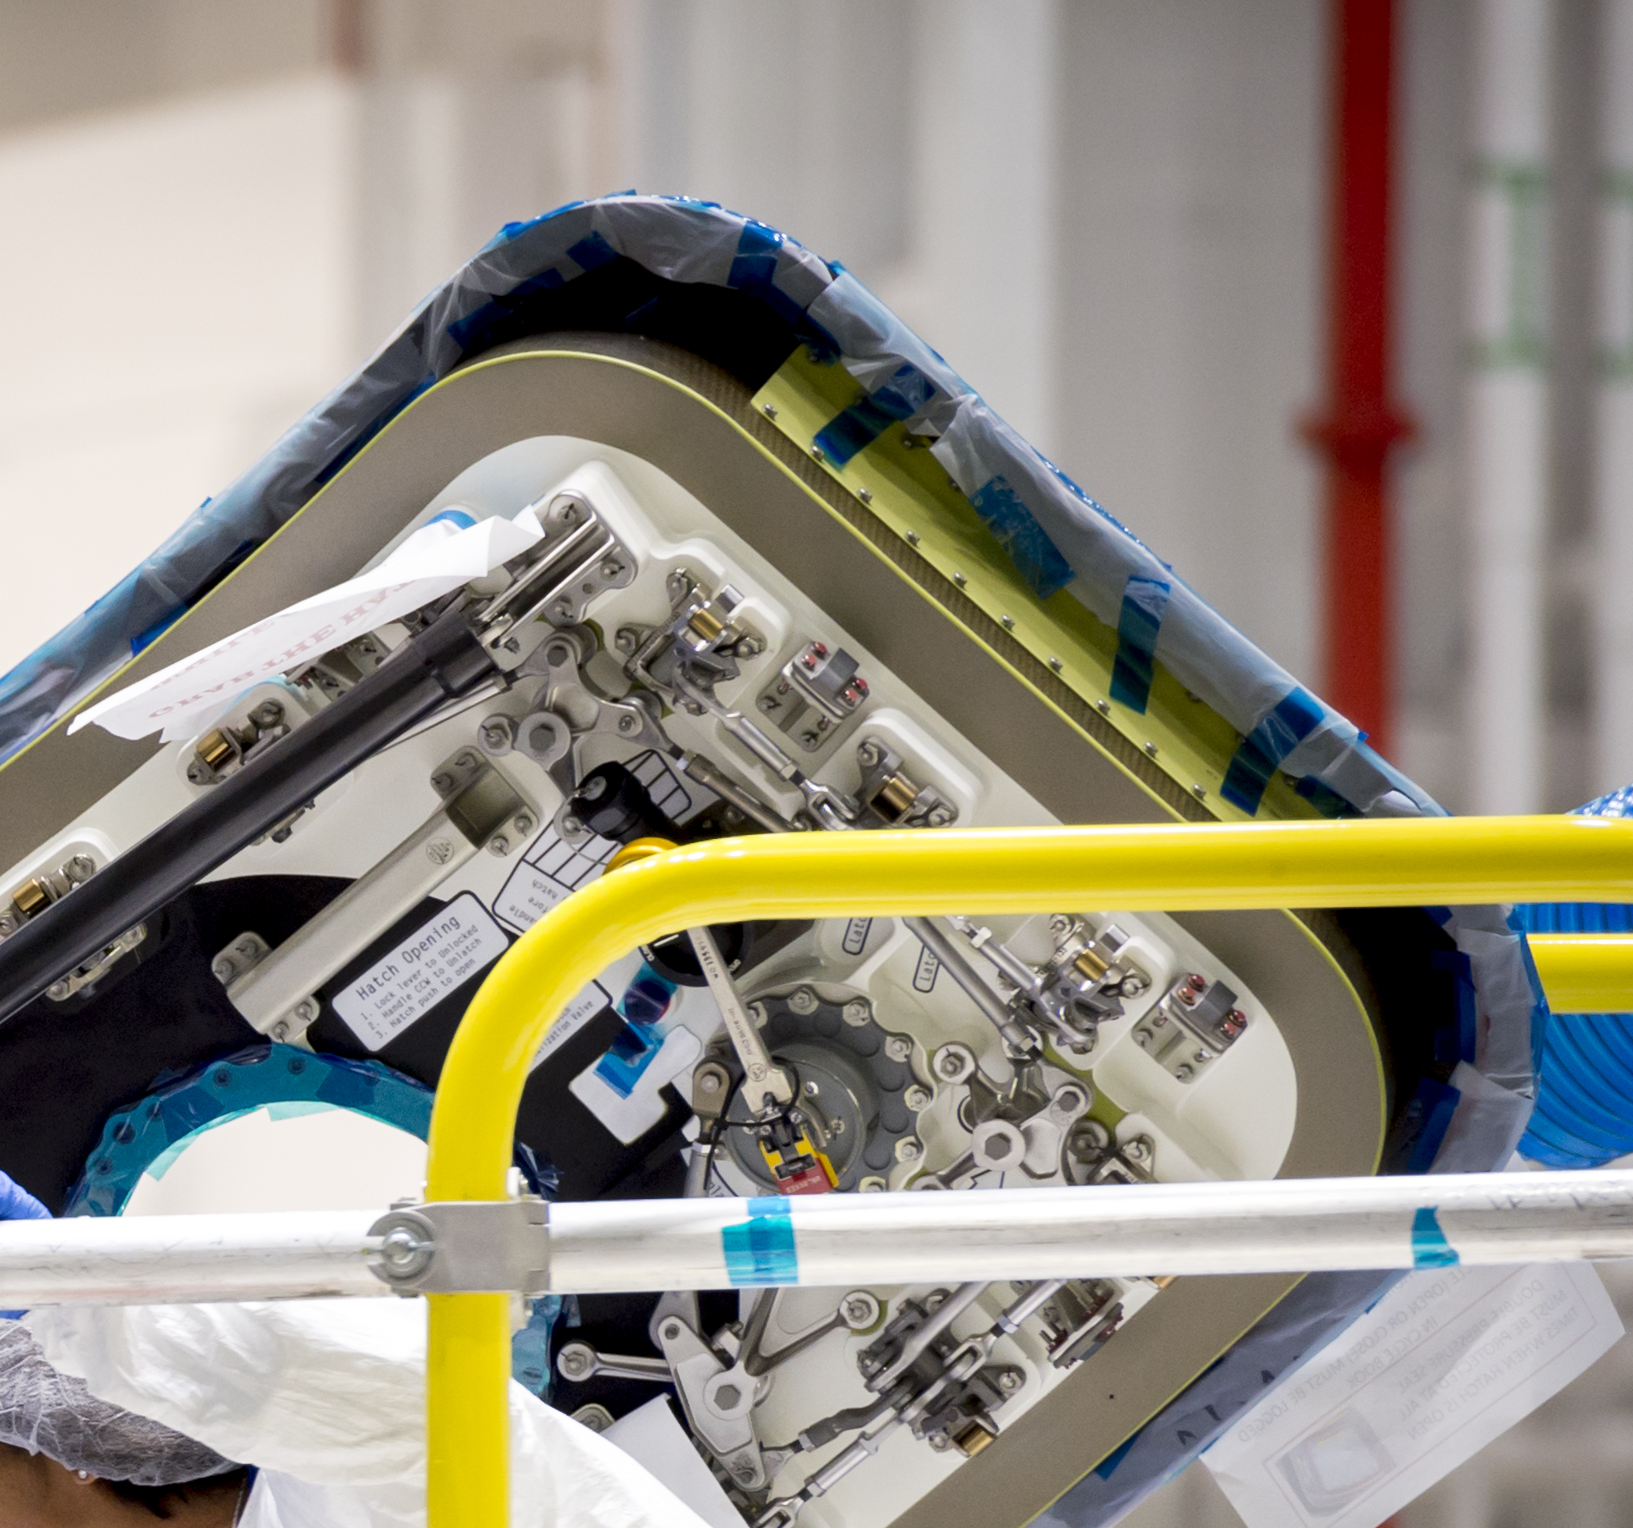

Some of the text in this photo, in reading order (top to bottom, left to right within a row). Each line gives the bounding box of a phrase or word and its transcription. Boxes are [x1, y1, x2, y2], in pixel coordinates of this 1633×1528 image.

[355, 916, 461, 1001] Hatch Opening
[374, 990, 396, 1010] Lock
[397, 968, 422, 990] lever
[425, 957, 437, 969] to
[438, 924, 479, 959] Unlocked
[849, 917, 868, 944] Latc
[919, 952, 935, 982] Latc
[381, 992, 413, 1019] Handle
[433, 967, 445, 978] to
[445, 937, 482, 968] Unlatch
[389, 1005, 416, 1028] Hatch
[418, 986, 439, 1008] push
[440, 976, 453, 987] to
[455, 958, 476, 977] open
